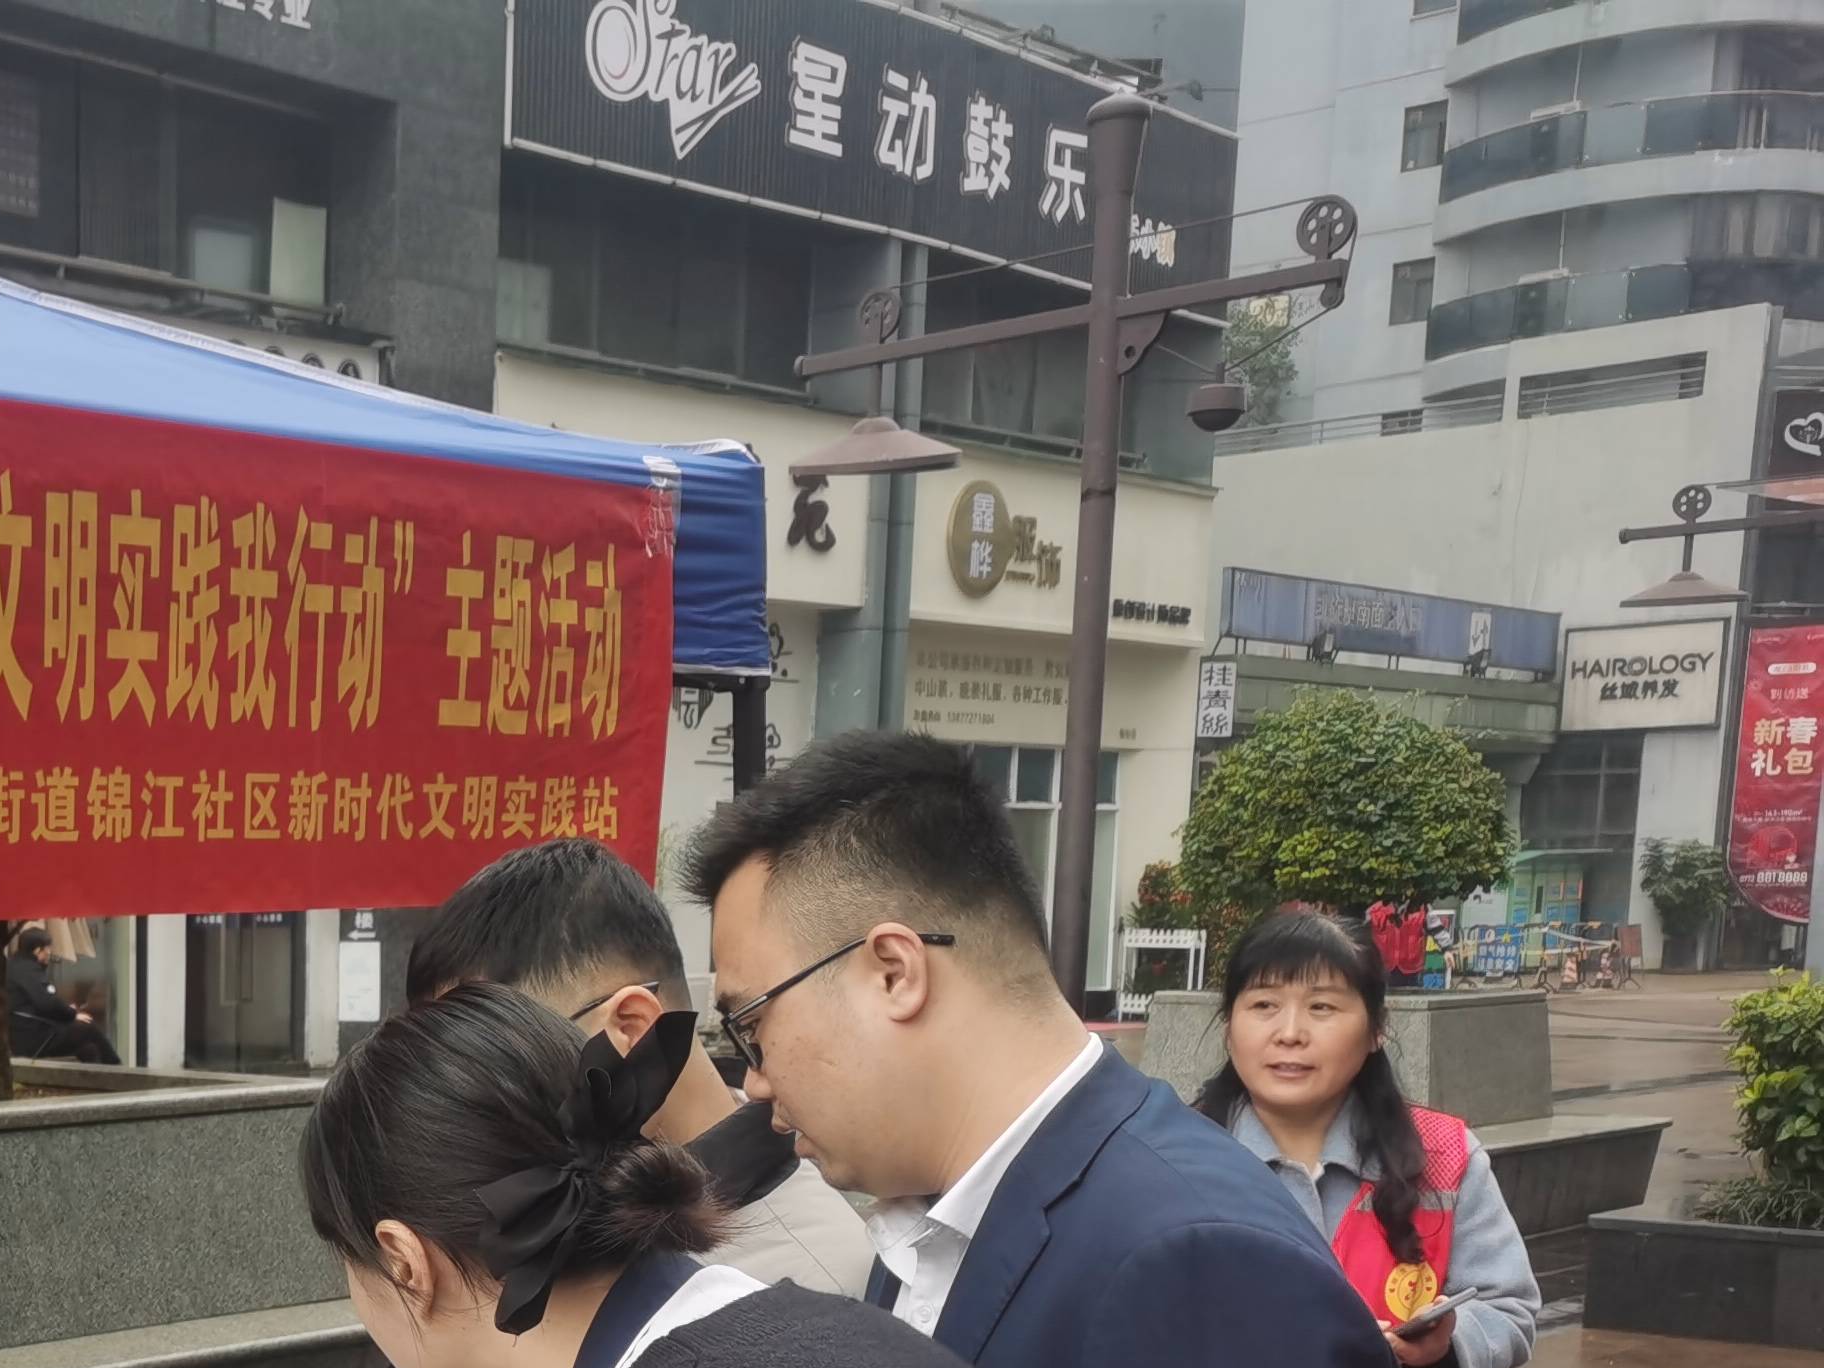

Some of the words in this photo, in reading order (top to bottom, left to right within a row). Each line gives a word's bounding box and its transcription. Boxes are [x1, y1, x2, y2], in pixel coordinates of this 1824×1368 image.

[786, 38, 1089, 227] 星动鼓乐
[1572, 651, 1714, 680] HAIROLOGY
[1753, 717, 1818, 745] 新春
[1751, 747, 1814, 777] 礼包
